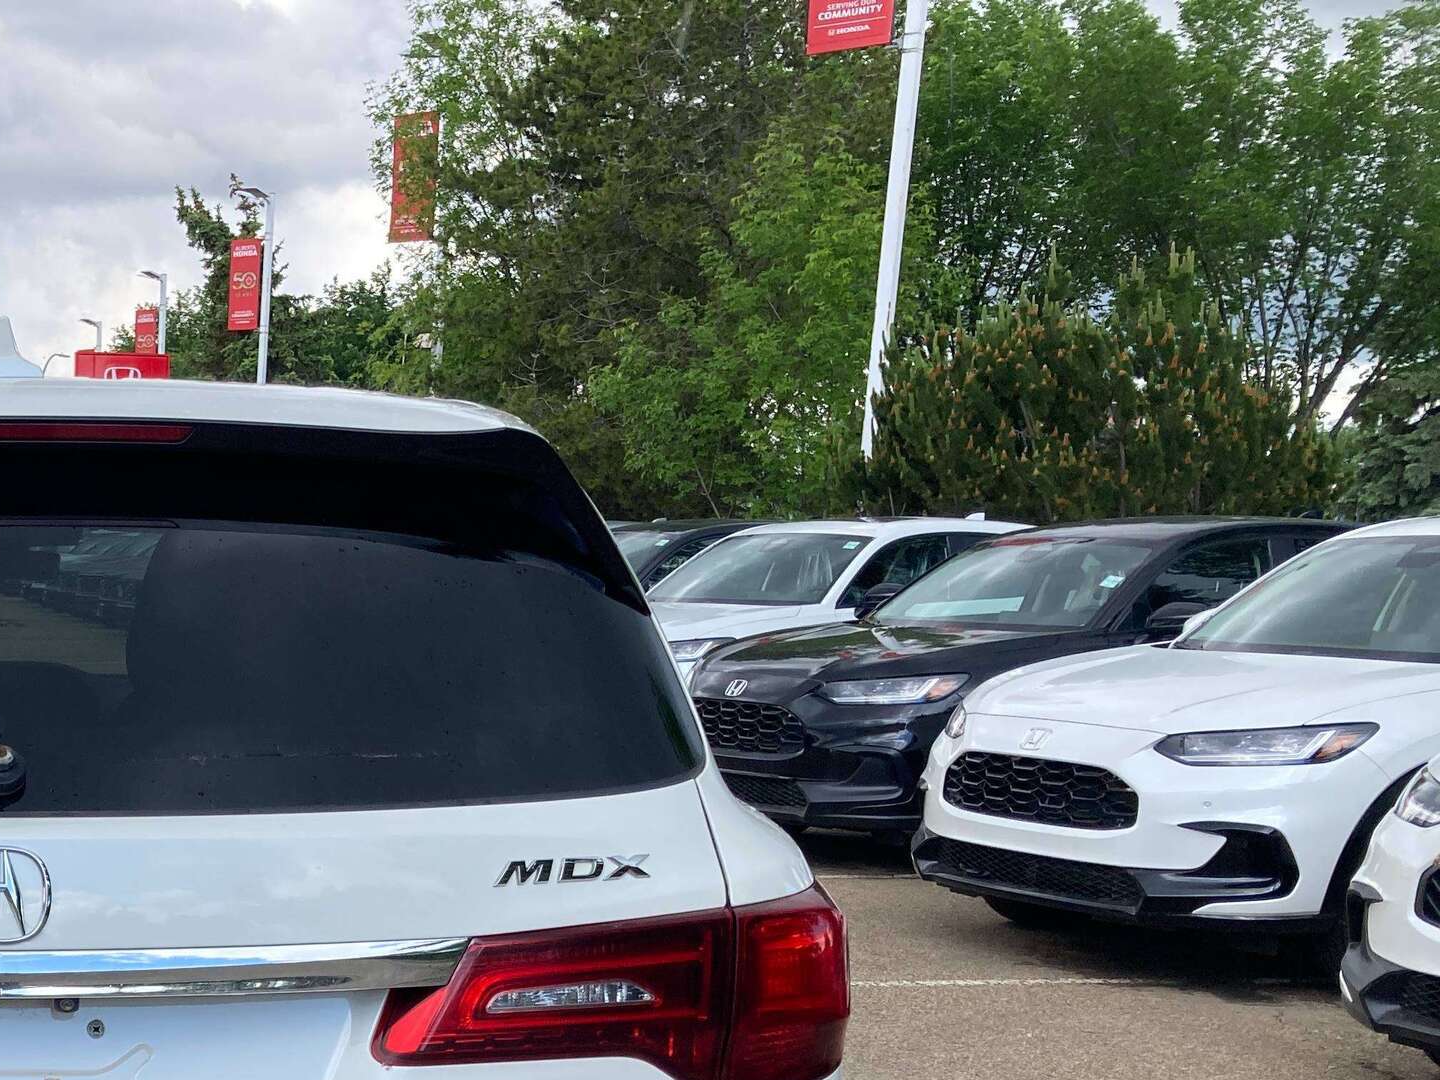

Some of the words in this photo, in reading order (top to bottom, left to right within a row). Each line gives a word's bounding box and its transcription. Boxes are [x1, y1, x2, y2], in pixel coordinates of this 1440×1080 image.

[817, 4, 884, 21] COMMUNITY
[826, 1, 860, 11] SERVING
[836, 24, 871, 35] HONDA
[232, 250, 258, 258] HONDA
[232, 271, 257, 290] 50
[492, 853, 651, 888] MDX
